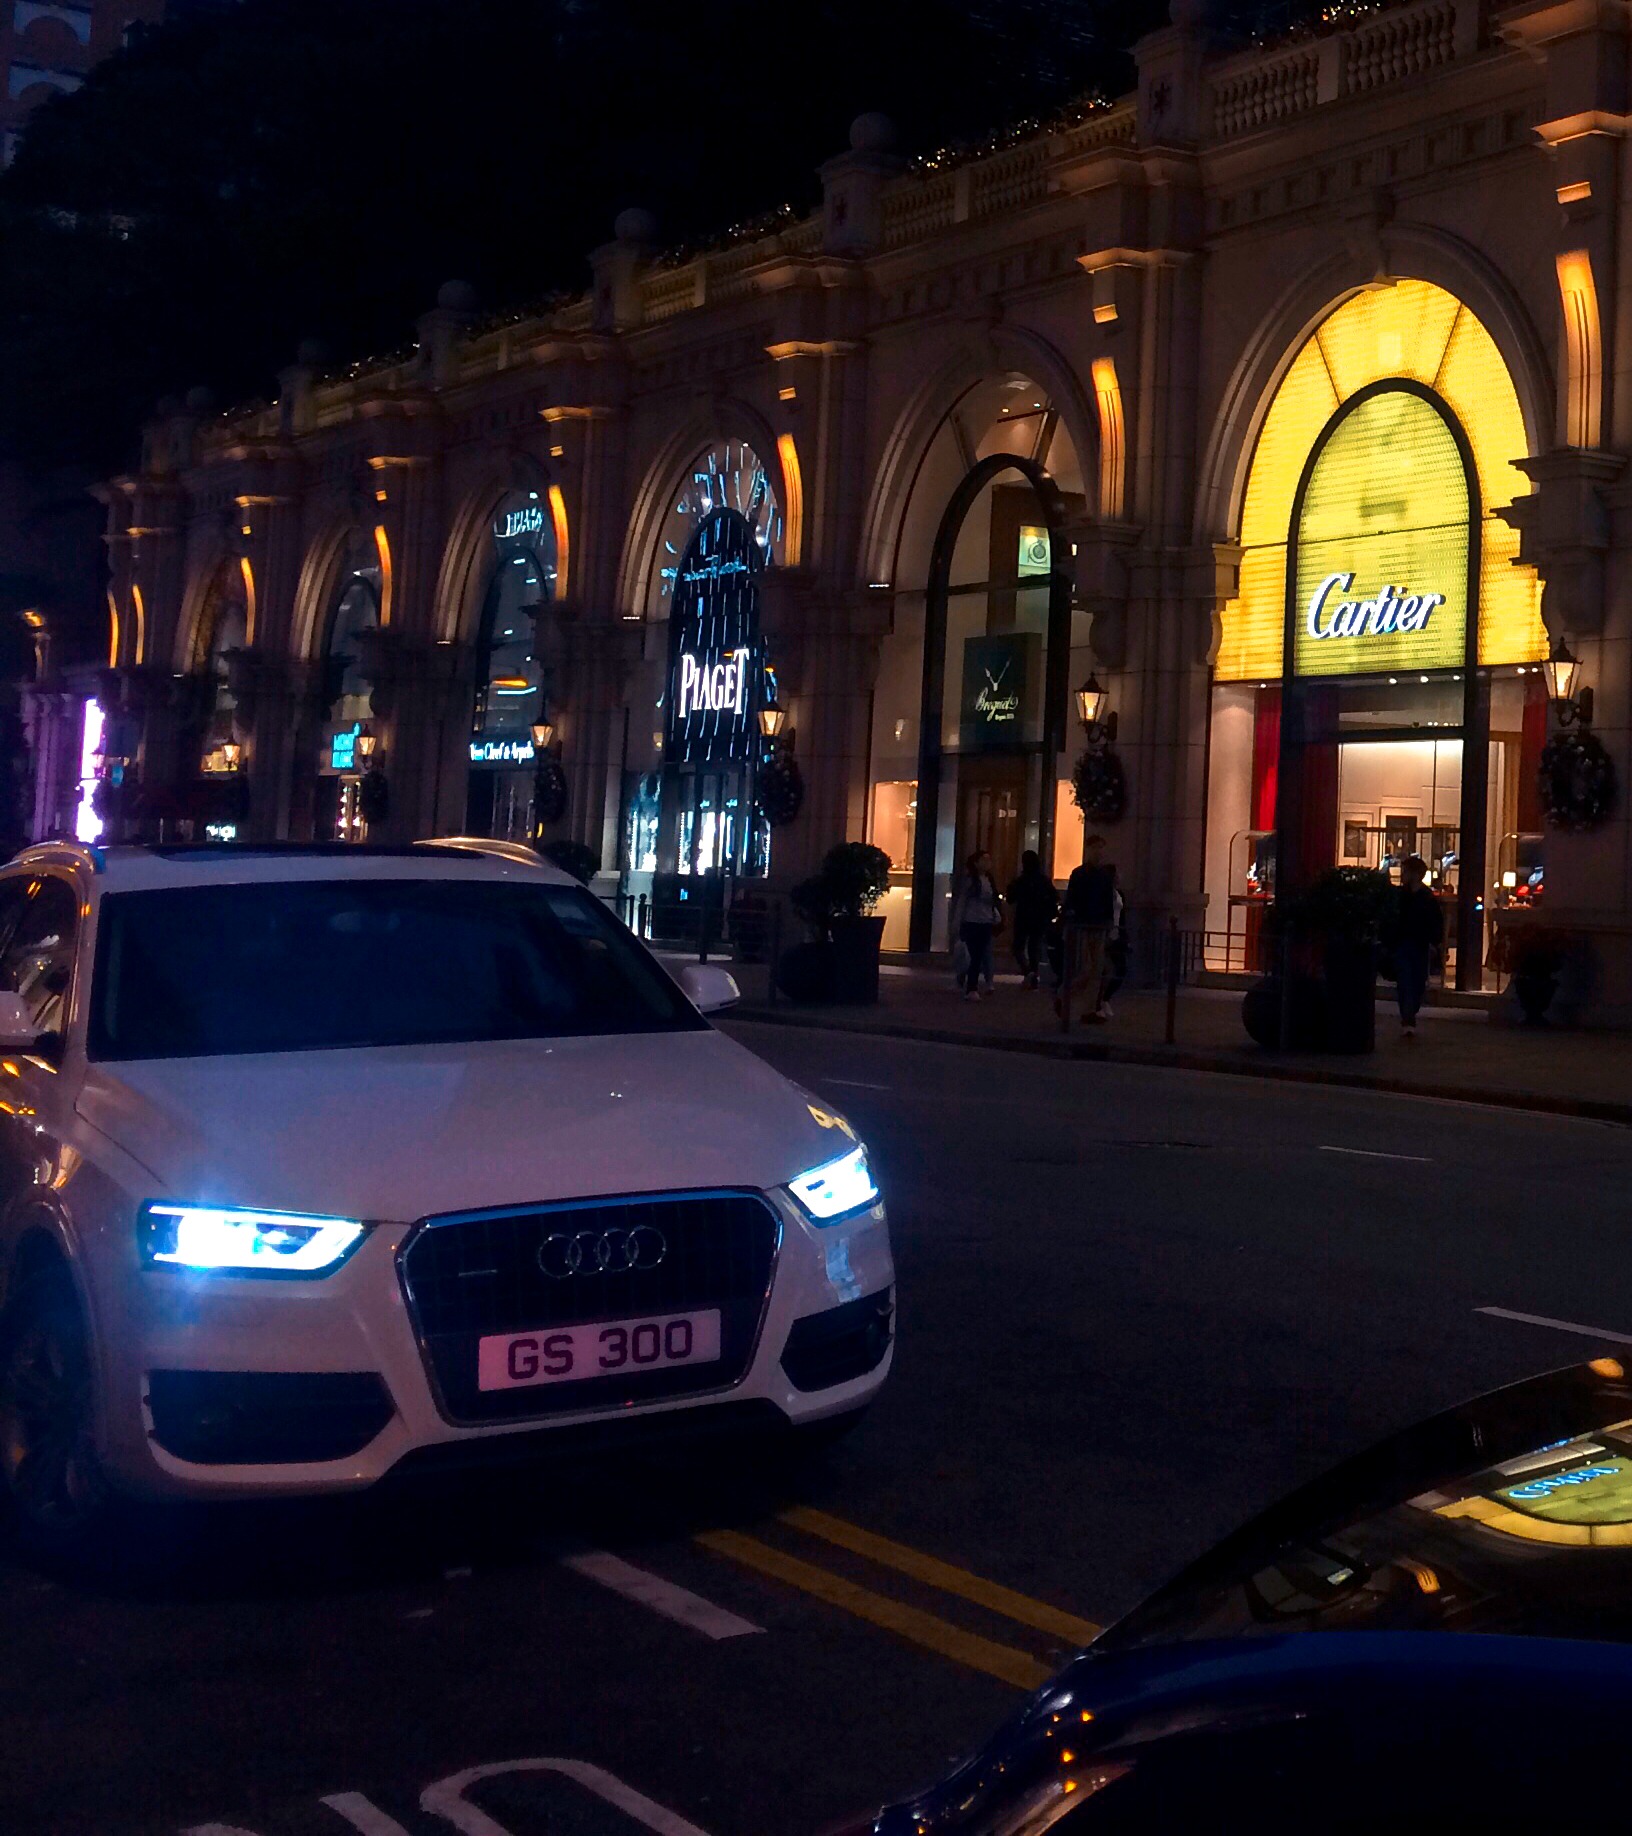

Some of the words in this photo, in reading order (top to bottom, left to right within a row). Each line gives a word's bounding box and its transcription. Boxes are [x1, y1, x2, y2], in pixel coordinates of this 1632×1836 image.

[1307, 572, 1446, 640] Cartier
[508, 1334, 574, 1380] GS
[598, 1319, 693, 1368] 300
